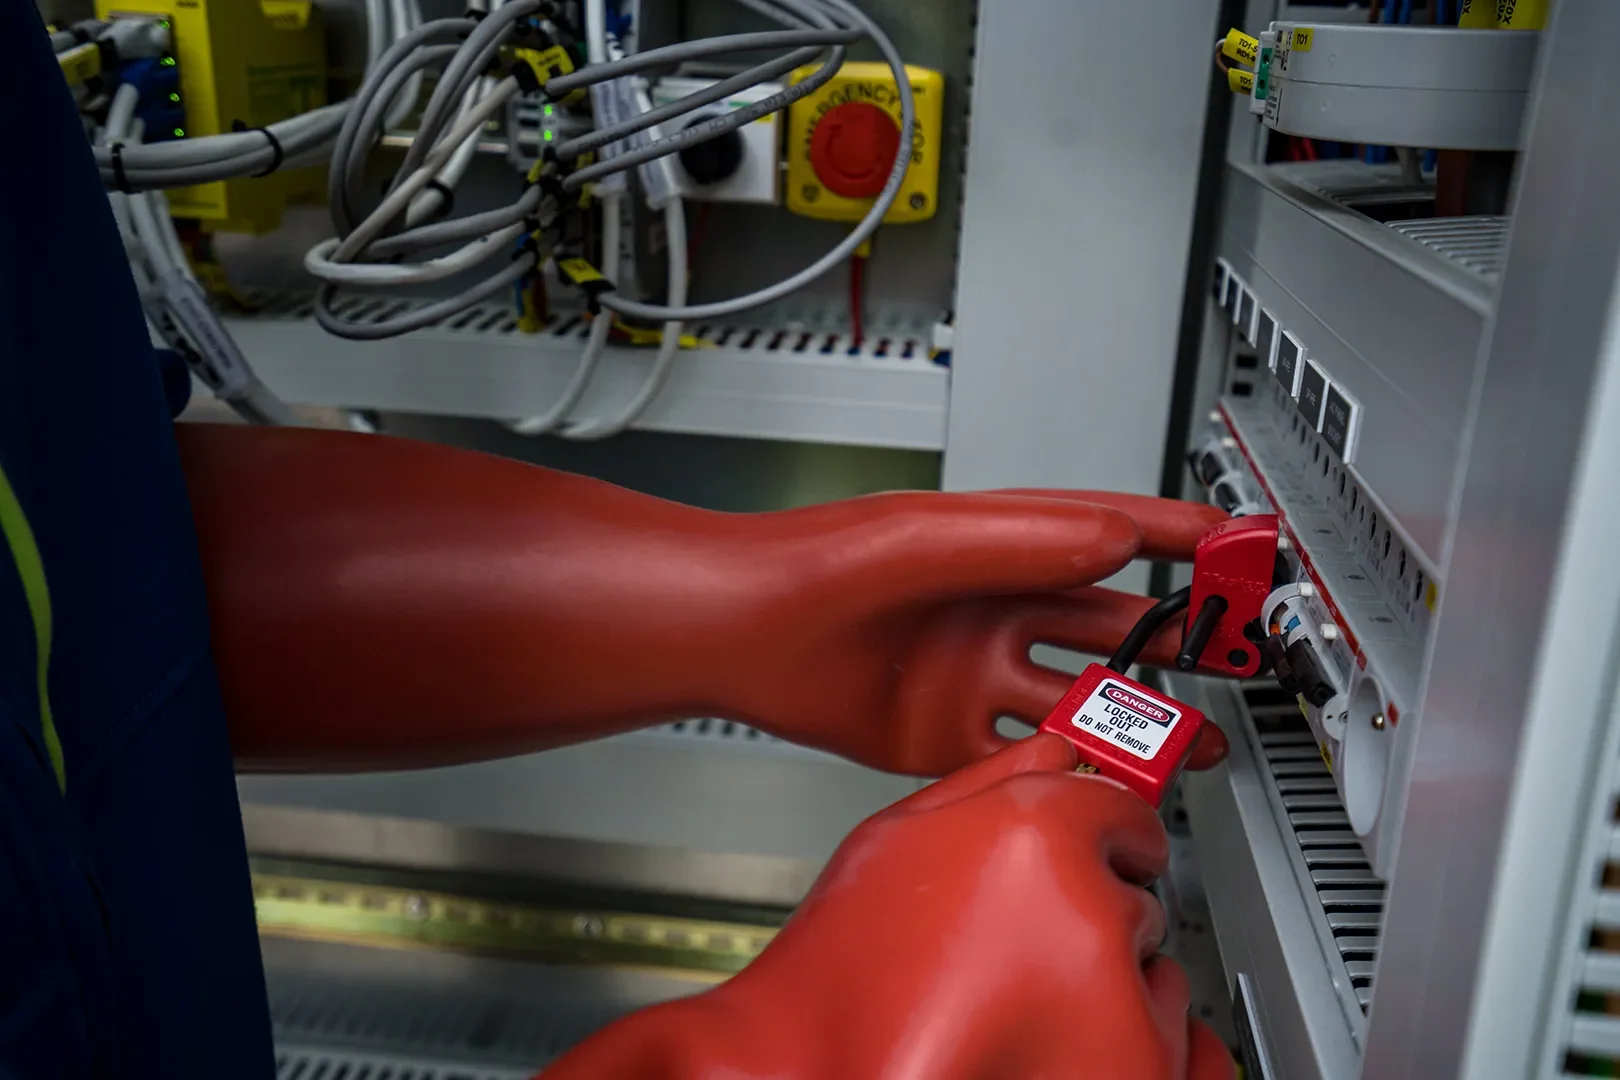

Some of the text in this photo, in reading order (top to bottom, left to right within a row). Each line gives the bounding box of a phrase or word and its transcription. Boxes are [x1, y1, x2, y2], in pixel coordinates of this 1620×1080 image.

[1104, 703, 1149, 730] LOCKED
[1112, 691, 1164, 719] DANGER
[1078, 714, 1151, 754] DO NOT REMOVE
[1109, 716, 1134, 732] OUT
